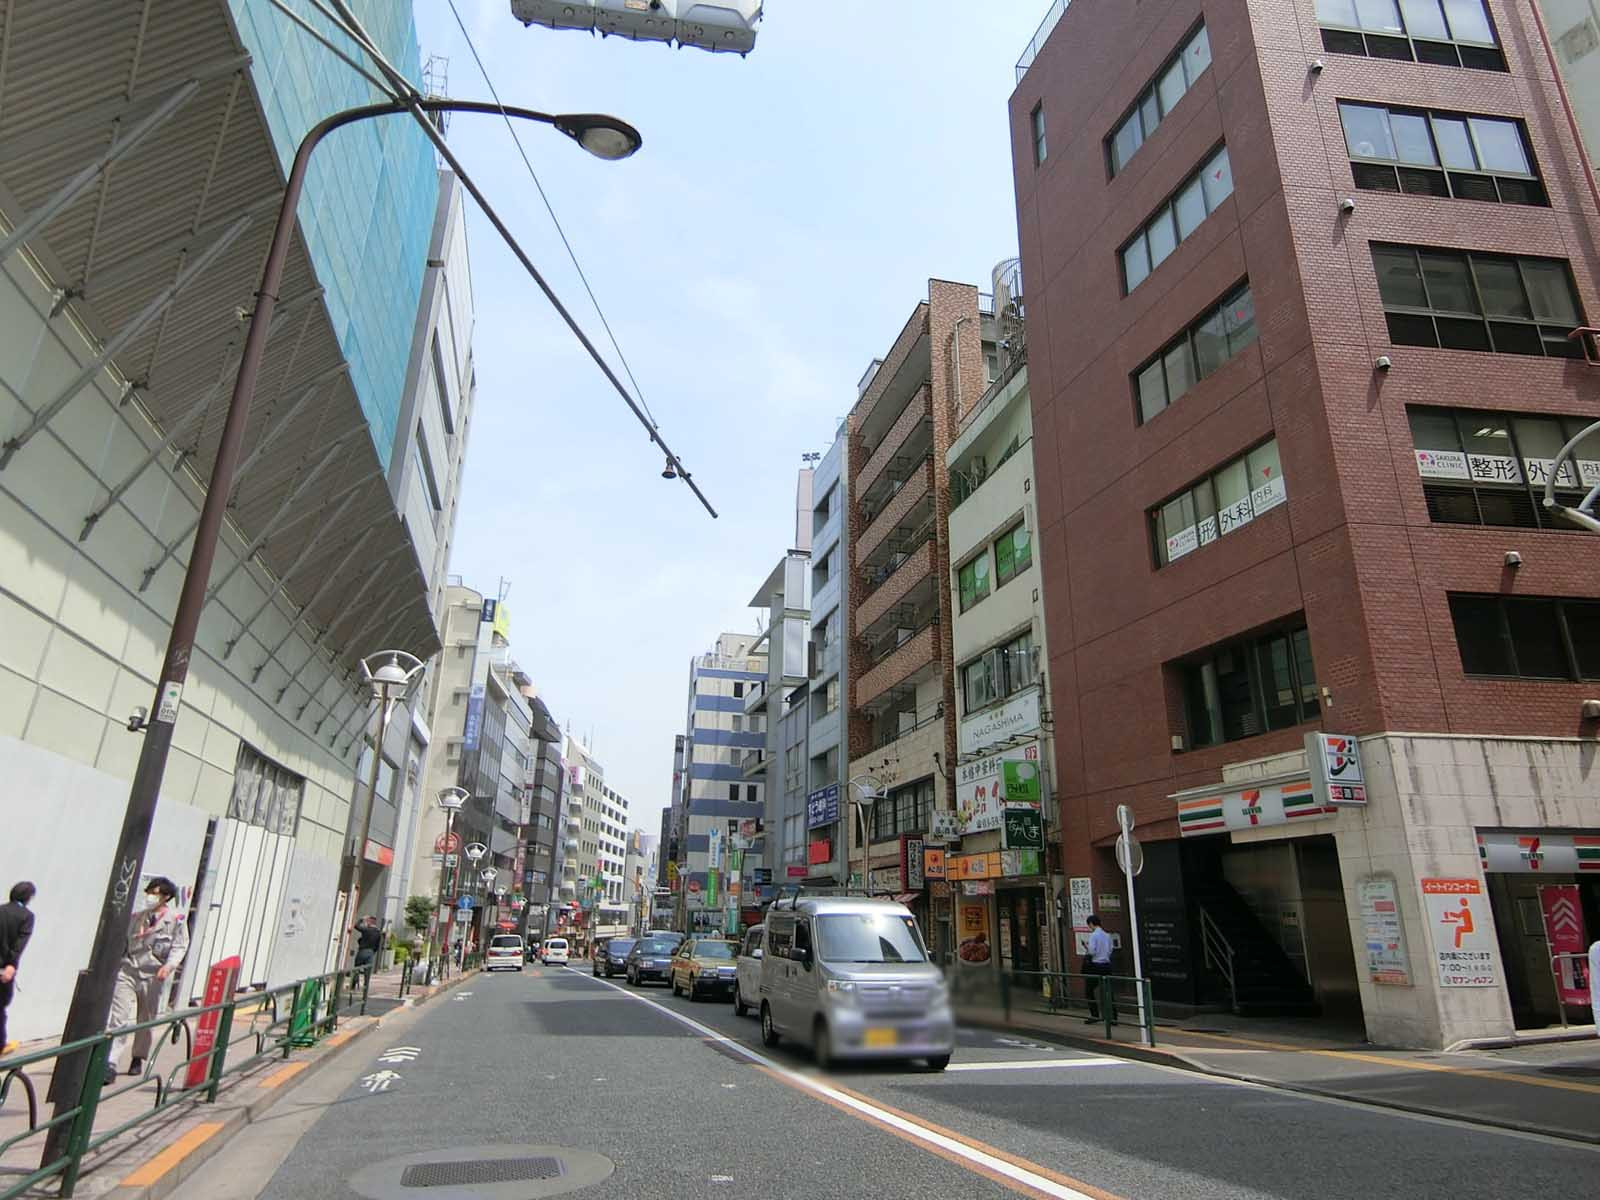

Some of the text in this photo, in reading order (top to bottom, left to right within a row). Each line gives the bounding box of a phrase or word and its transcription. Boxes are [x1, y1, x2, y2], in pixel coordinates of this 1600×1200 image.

[1436, 461, 1464, 470] CLINIC
[1470, 457, 1517, 480] 整形
[1221, 498, 1253, 533] 外科
[1072, 880, 1089, 895] 整形
[1072, 898, 1091, 912] 外科
